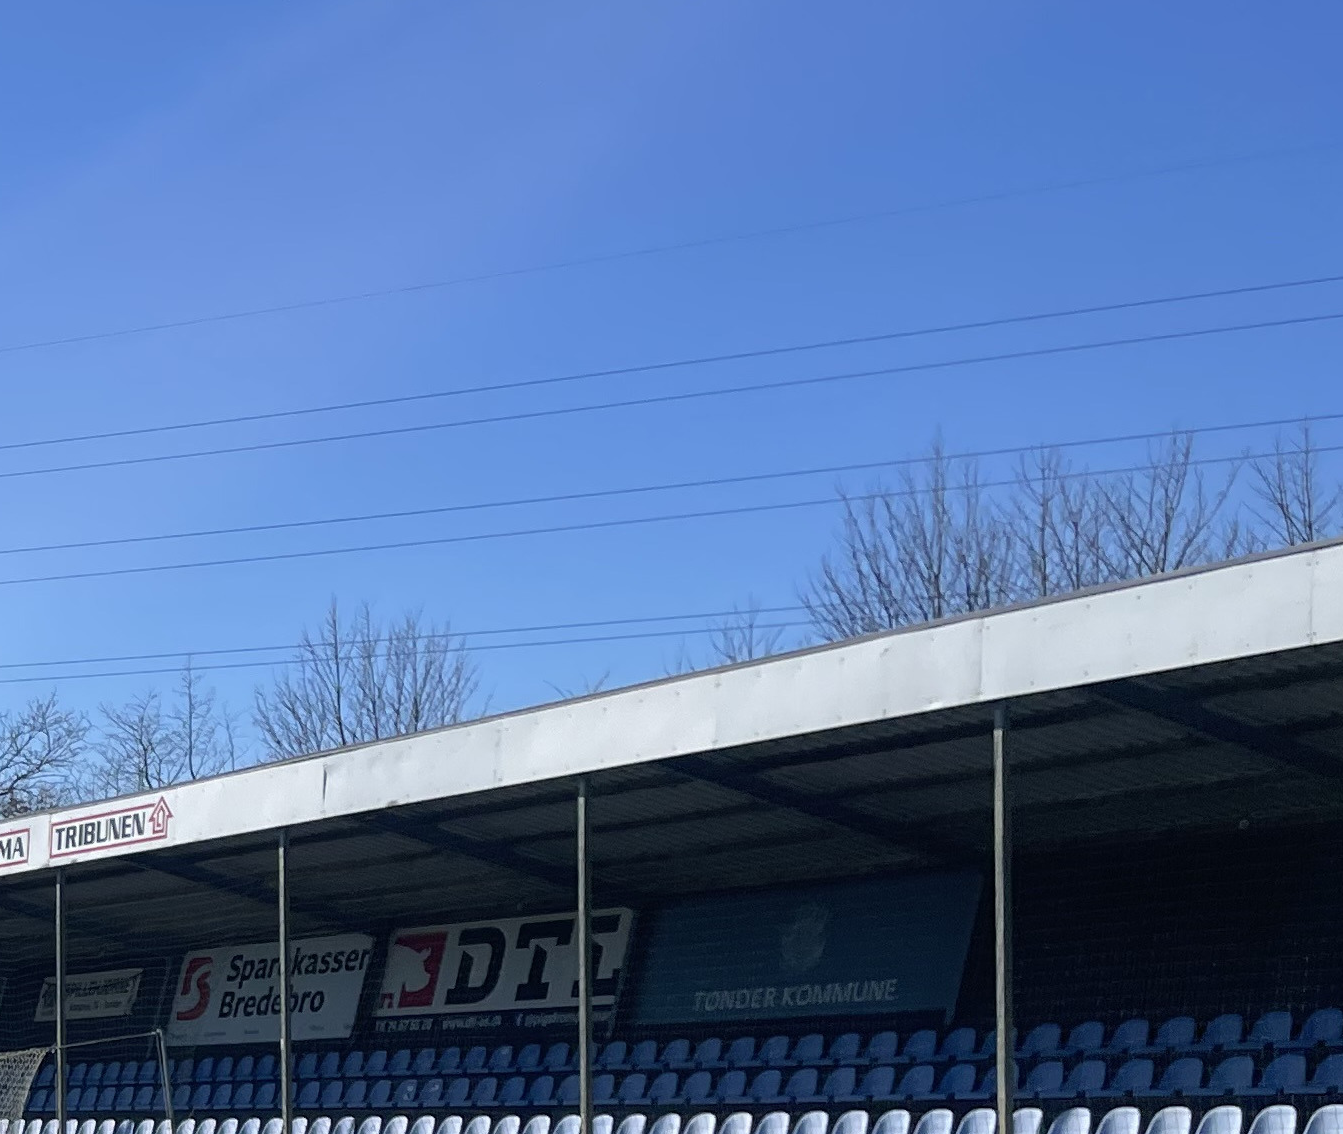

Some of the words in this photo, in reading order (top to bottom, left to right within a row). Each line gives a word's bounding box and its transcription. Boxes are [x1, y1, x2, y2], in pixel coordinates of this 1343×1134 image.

[55, 811, 147, 851] TRIBUNEN
[227, 947, 370, 990] Sparkasse
[782, 978, 898, 1006] KOMMUNE
